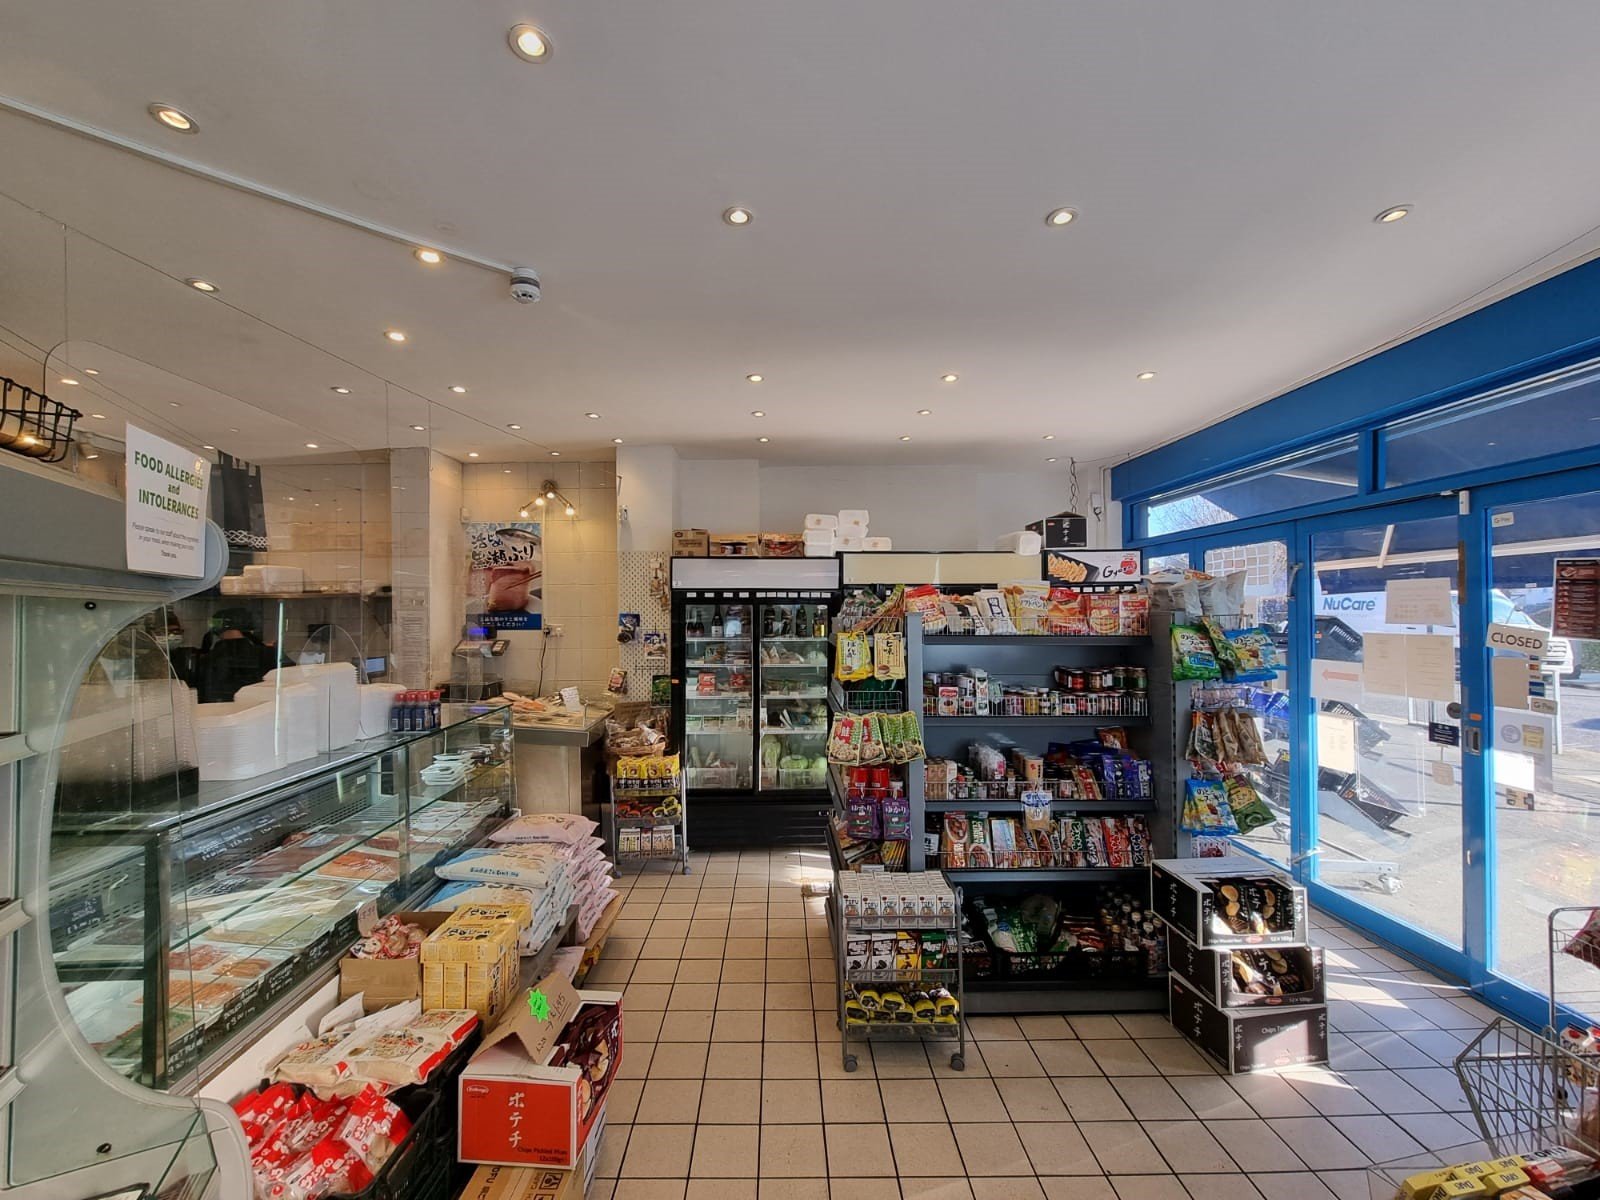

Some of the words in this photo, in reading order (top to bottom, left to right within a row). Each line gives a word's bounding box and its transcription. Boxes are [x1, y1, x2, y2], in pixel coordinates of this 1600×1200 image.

[134, 450, 163, 474] FOOD
[165, 463, 204, 490] ALLERGIES
[167, 483, 180, 496] and
[138, 488, 199, 519] INTOLERANCES
[1322, 597, 1376, 611] NuCare
[1491, 632, 1543, 650] CLOSED
[885, 804, 906, 813] ゆかり
[508, 1092, 525, 1148] ポテチ
